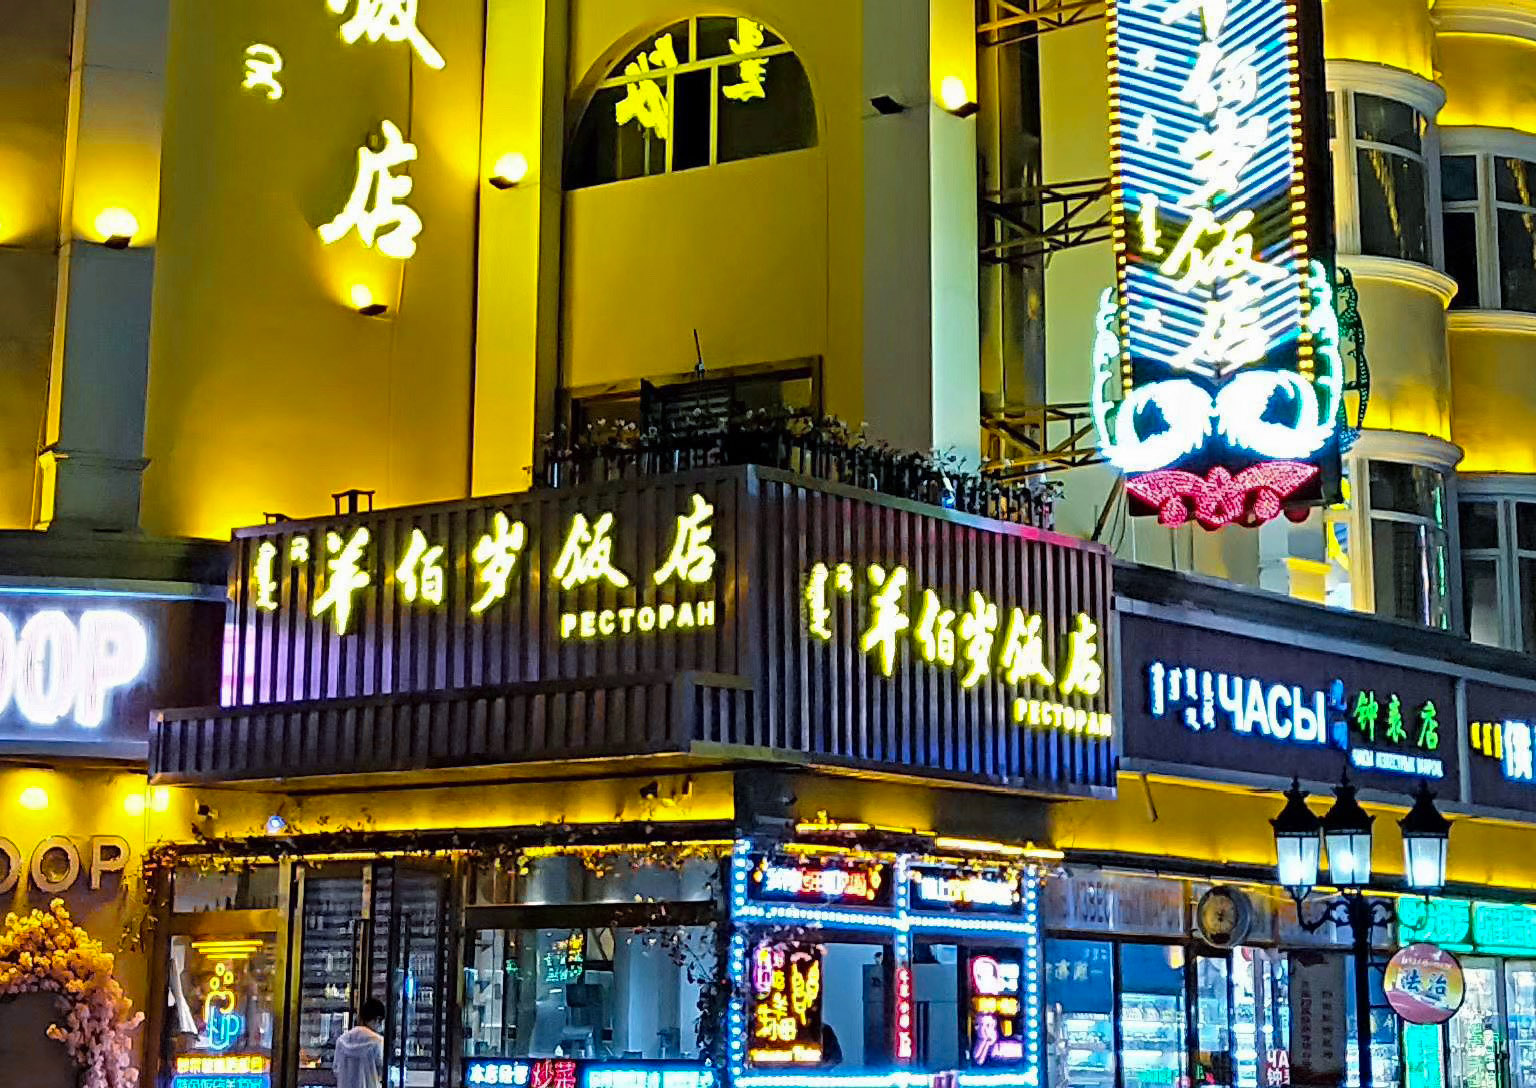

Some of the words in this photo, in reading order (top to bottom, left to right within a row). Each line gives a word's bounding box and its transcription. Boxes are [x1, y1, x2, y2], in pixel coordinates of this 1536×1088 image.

[313, 493, 717, 636] 羊佰岁饭店
[560, 601, 716, 639] РЕСТОРАН
[859, 563, 1104, 696] 羊佰岁饭店
[1013, 698, 1112, 738] РЕСТОРАН
[1218, 672, 1327, 745] ЧАСЫ
[1352, 689, 1440, 751] 钟表店
